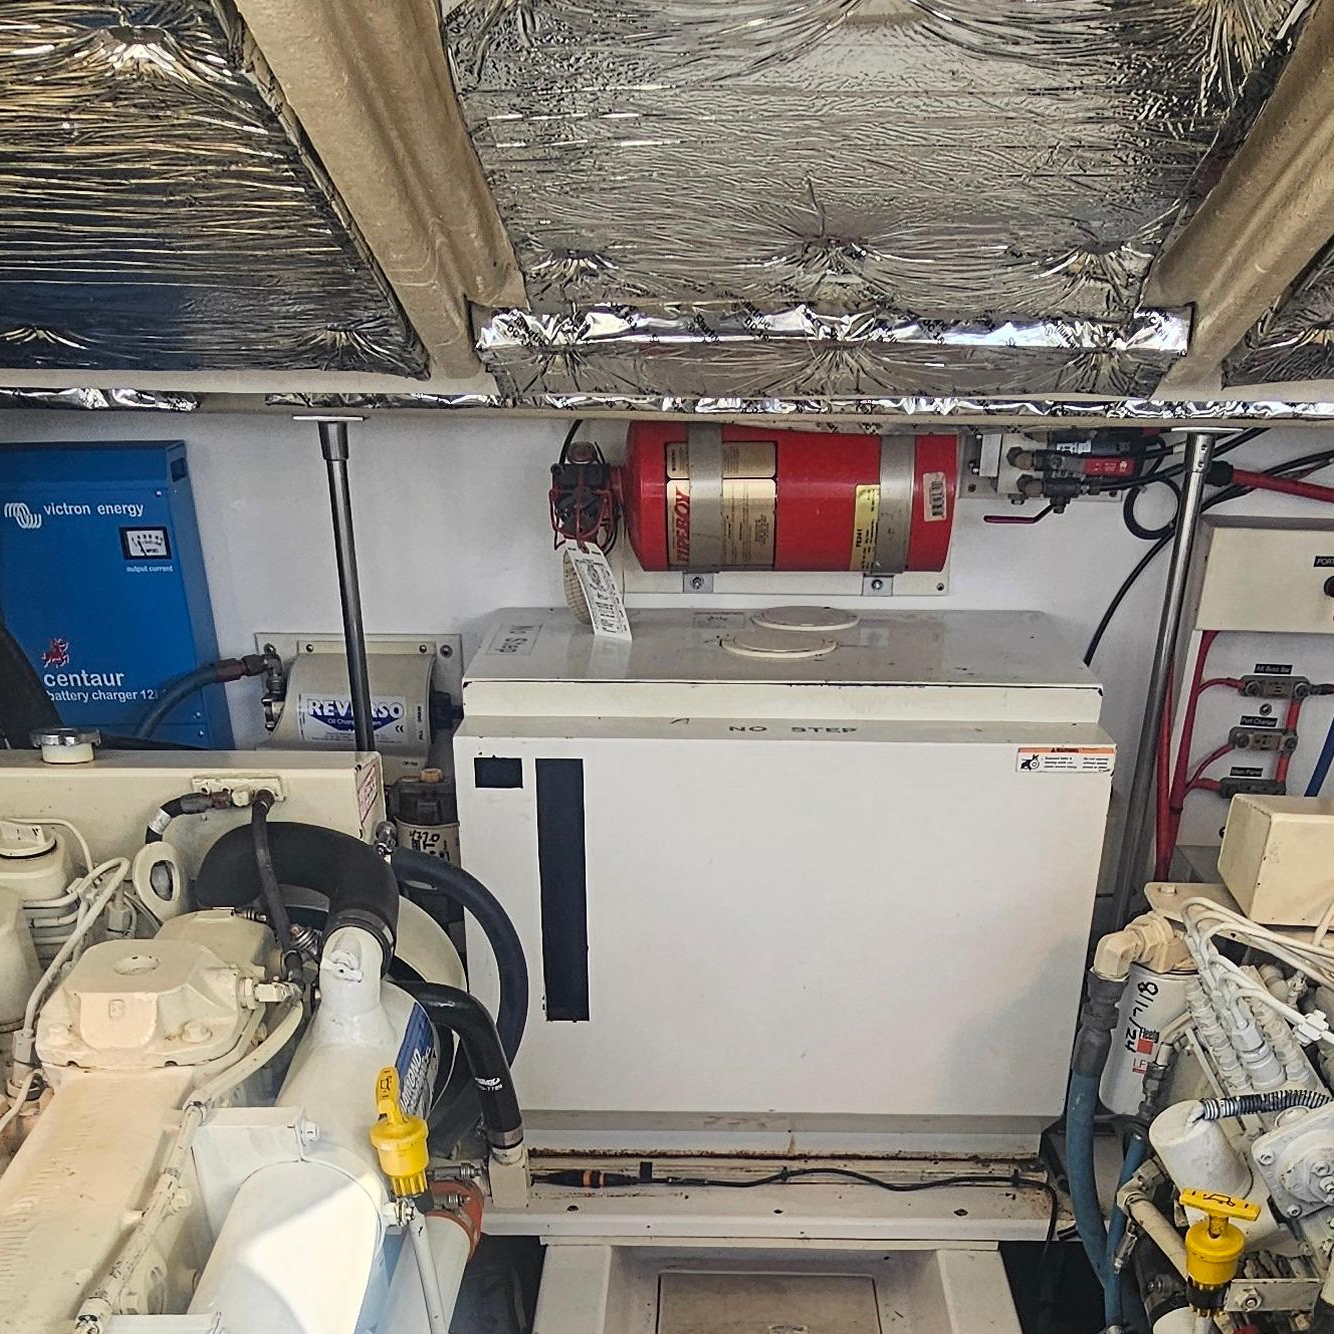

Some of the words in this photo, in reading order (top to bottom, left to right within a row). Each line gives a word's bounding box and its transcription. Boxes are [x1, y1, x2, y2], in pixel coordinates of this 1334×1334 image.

[43, 502, 91, 515] victron
[97, 503, 144, 517] energy
[1316, 557, 1334, 566] PORT
[43, 670, 126, 687] centaur
[47, 689, 89, 703] battery
[91, 689, 139, 703] charger
